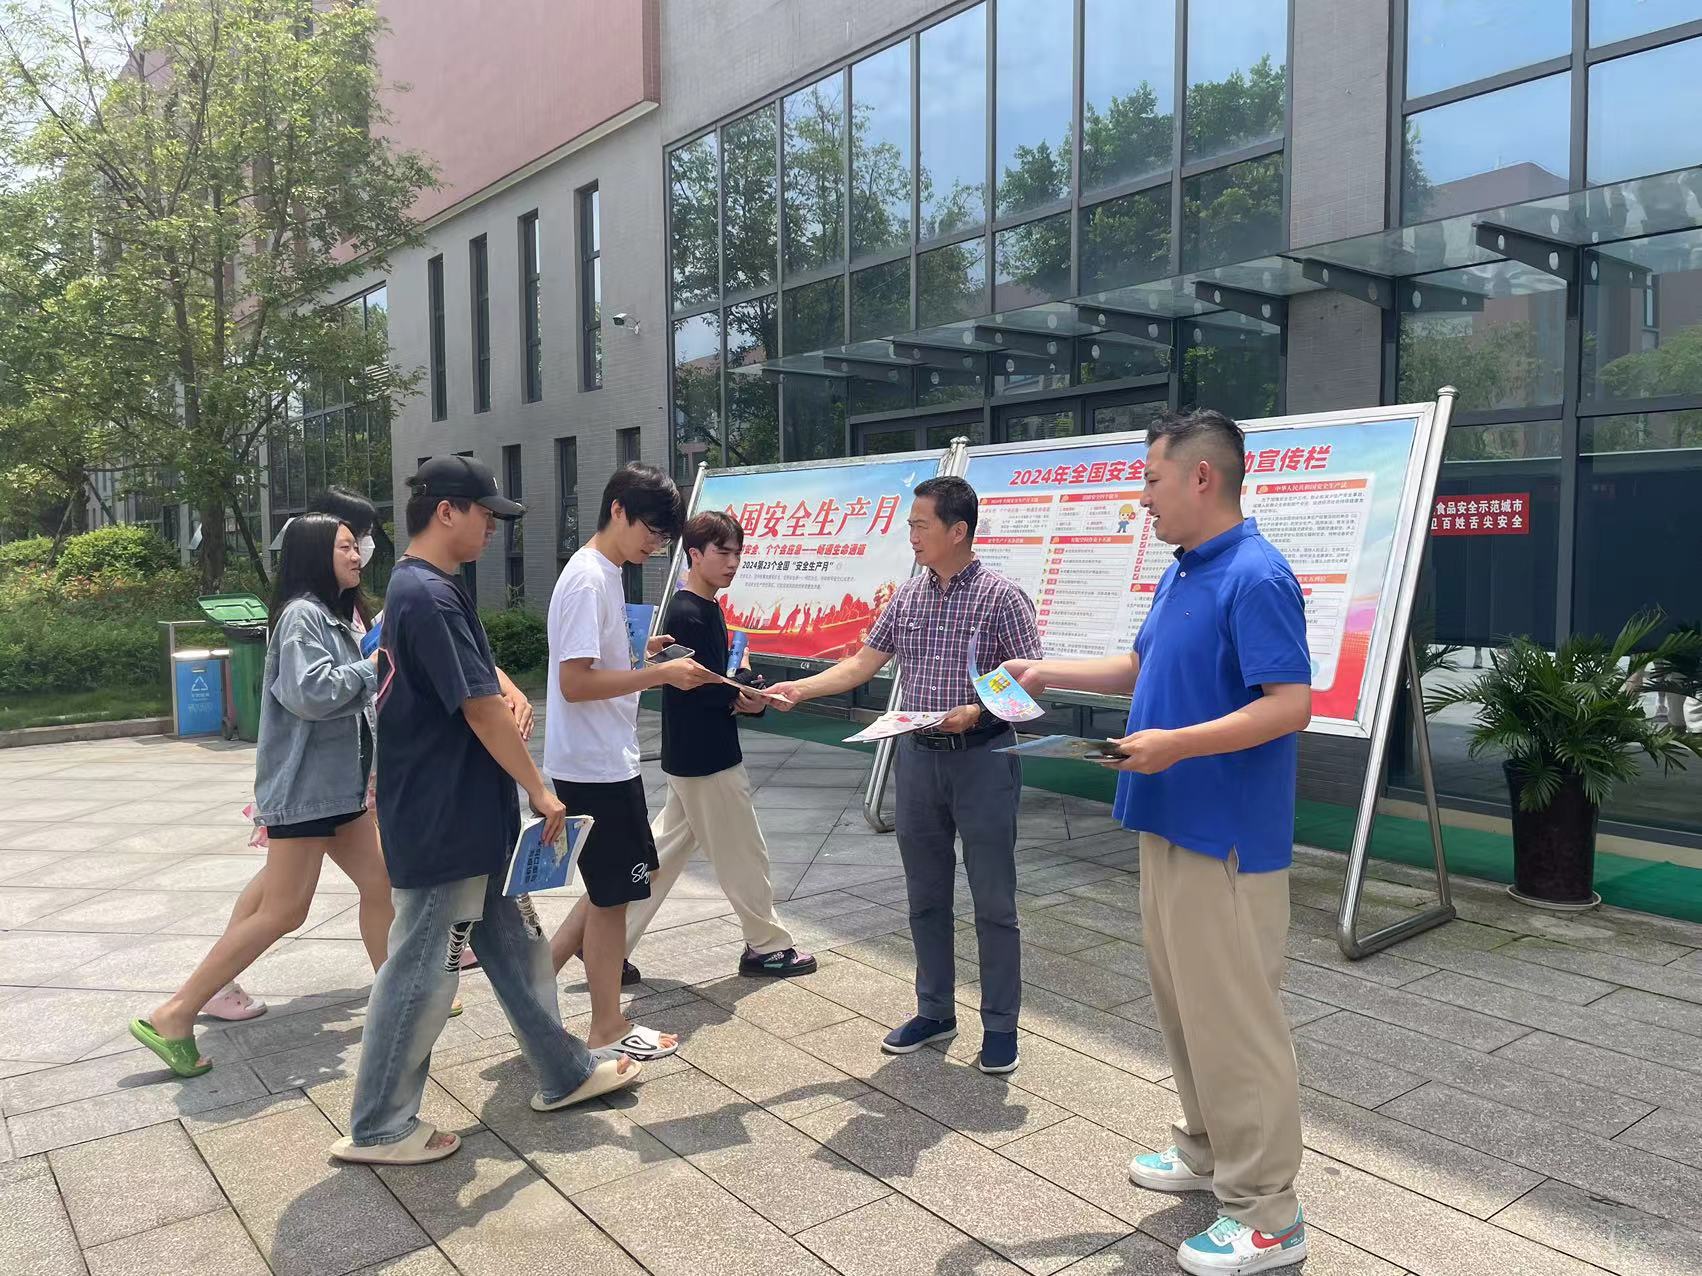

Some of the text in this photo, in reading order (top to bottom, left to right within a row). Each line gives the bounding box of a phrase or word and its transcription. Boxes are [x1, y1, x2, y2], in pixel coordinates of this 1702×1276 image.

[1010, 459, 1146, 485] 2024年全国安全
[1433, 499, 1523, 514] 食品安全示范城市
[741, 544, 867, 556] 安全、个个会应急——畅通生命通道
